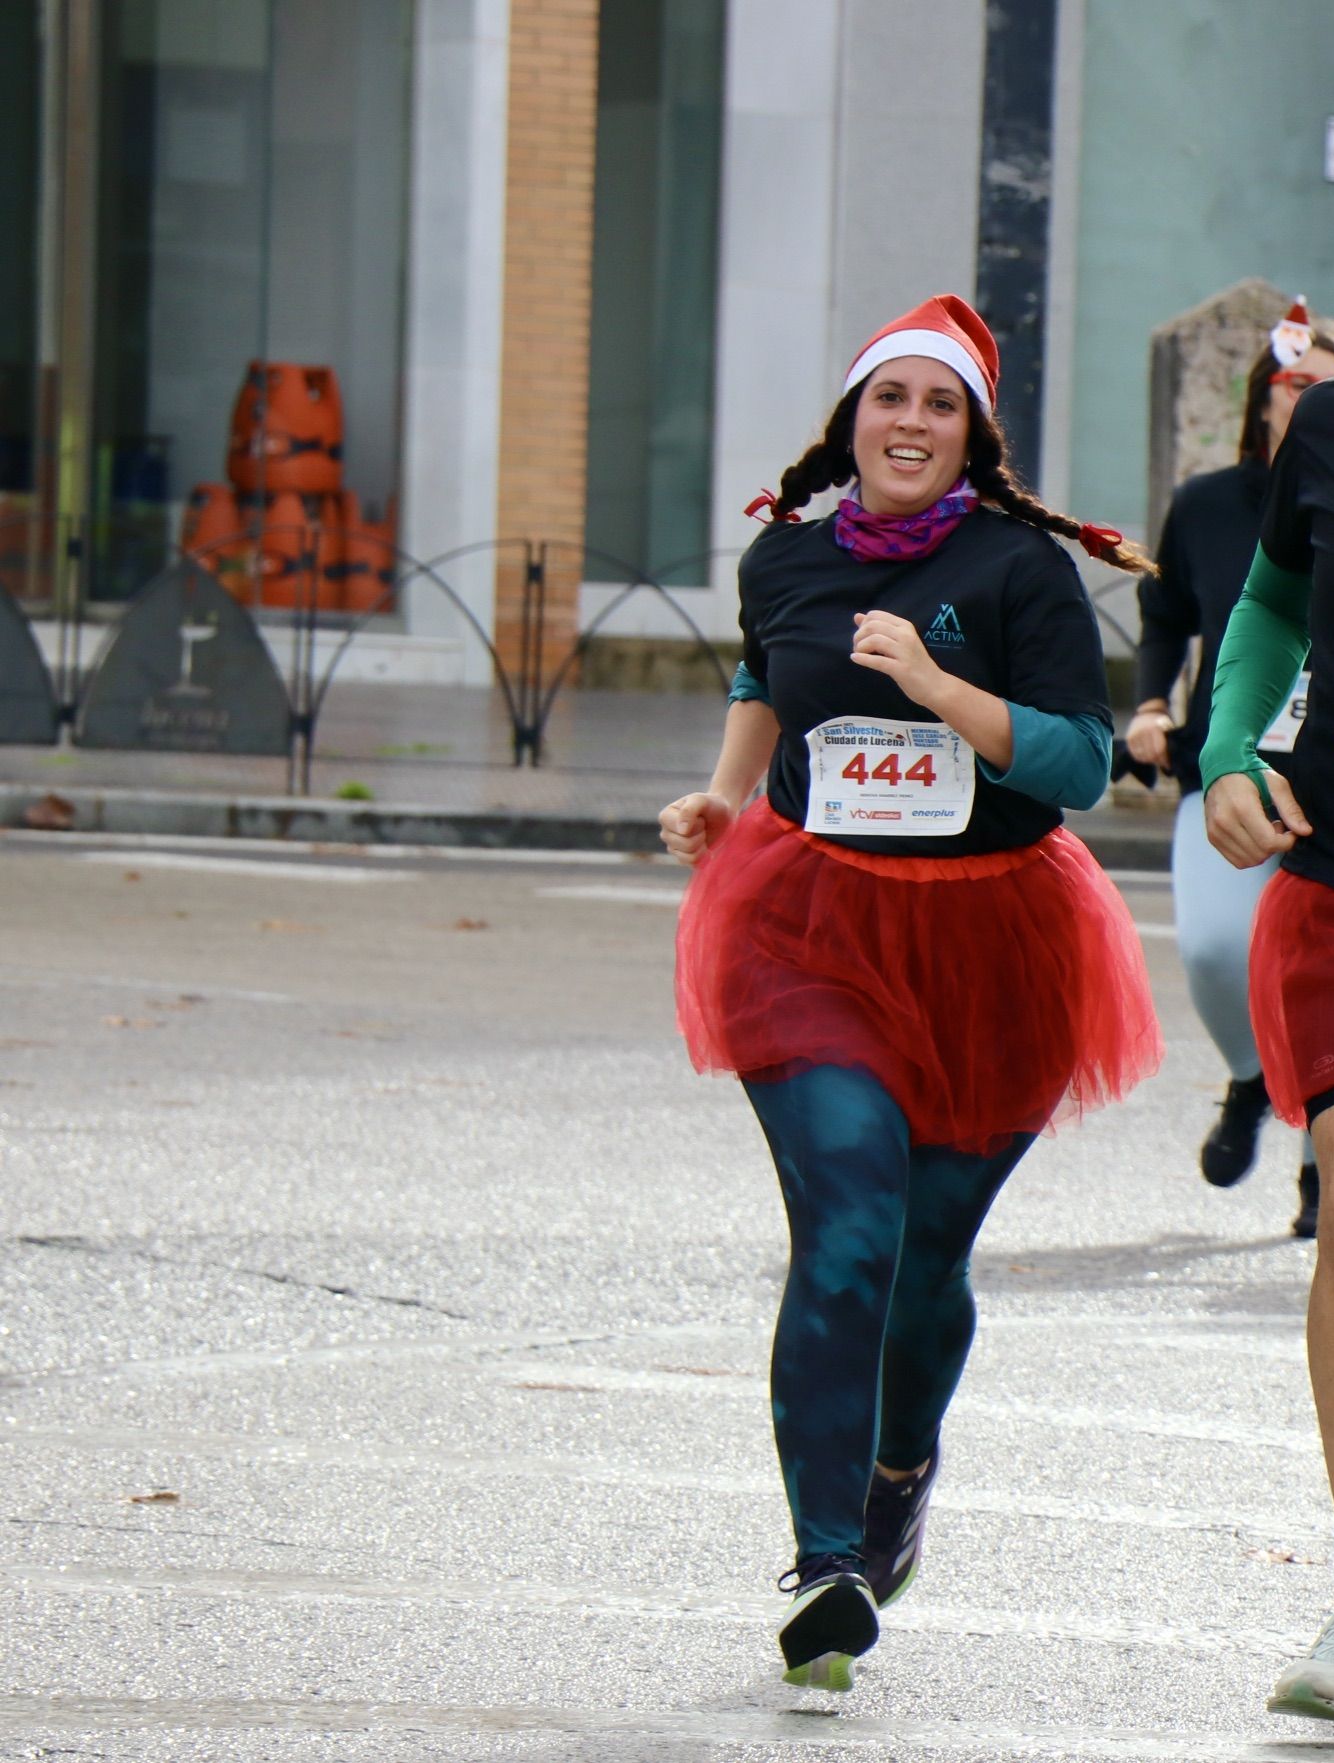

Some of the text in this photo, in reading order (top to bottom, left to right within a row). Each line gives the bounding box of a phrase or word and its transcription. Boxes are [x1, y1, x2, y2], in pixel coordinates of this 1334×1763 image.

[924, 630, 966, 643] ACTIVA
[823, 727, 842, 736] San
[843, 726, 884, 736] Silvestre
[824, 736, 856, 745] Ciudad
[858, 736, 868, 745] de
[870, 736, 905, 747] Lucena
[842, 752, 937, 787] 444
[850, 808, 873, 819] vtv
[911, 809, 955, 818] enerplus
